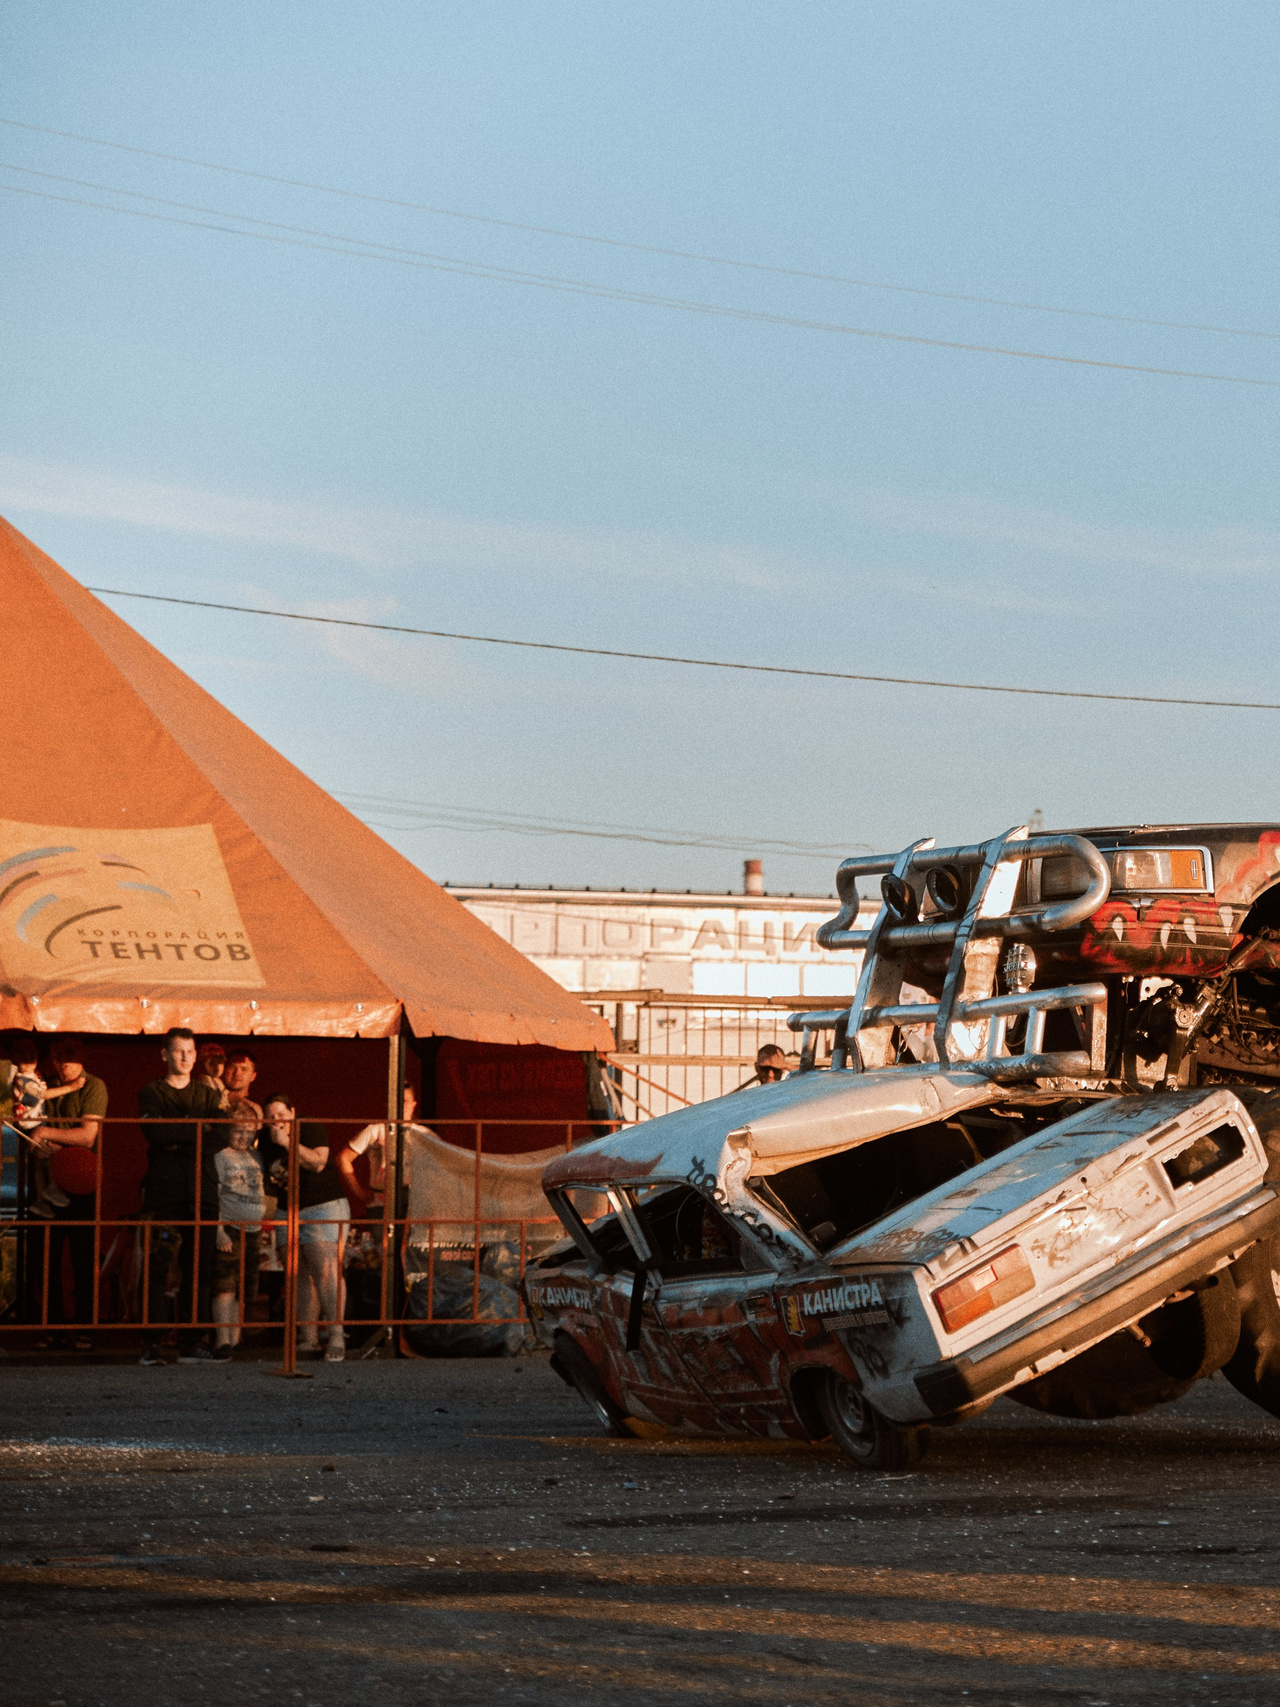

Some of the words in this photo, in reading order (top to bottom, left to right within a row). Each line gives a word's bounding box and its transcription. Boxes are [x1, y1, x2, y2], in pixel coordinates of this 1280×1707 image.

[77, 928, 246, 940] КОРПОРАЦИЯ
[81, 940, 251, 961] ТЕНТОВ
[803, 1282, 883, 1316] КАНИСТРА
